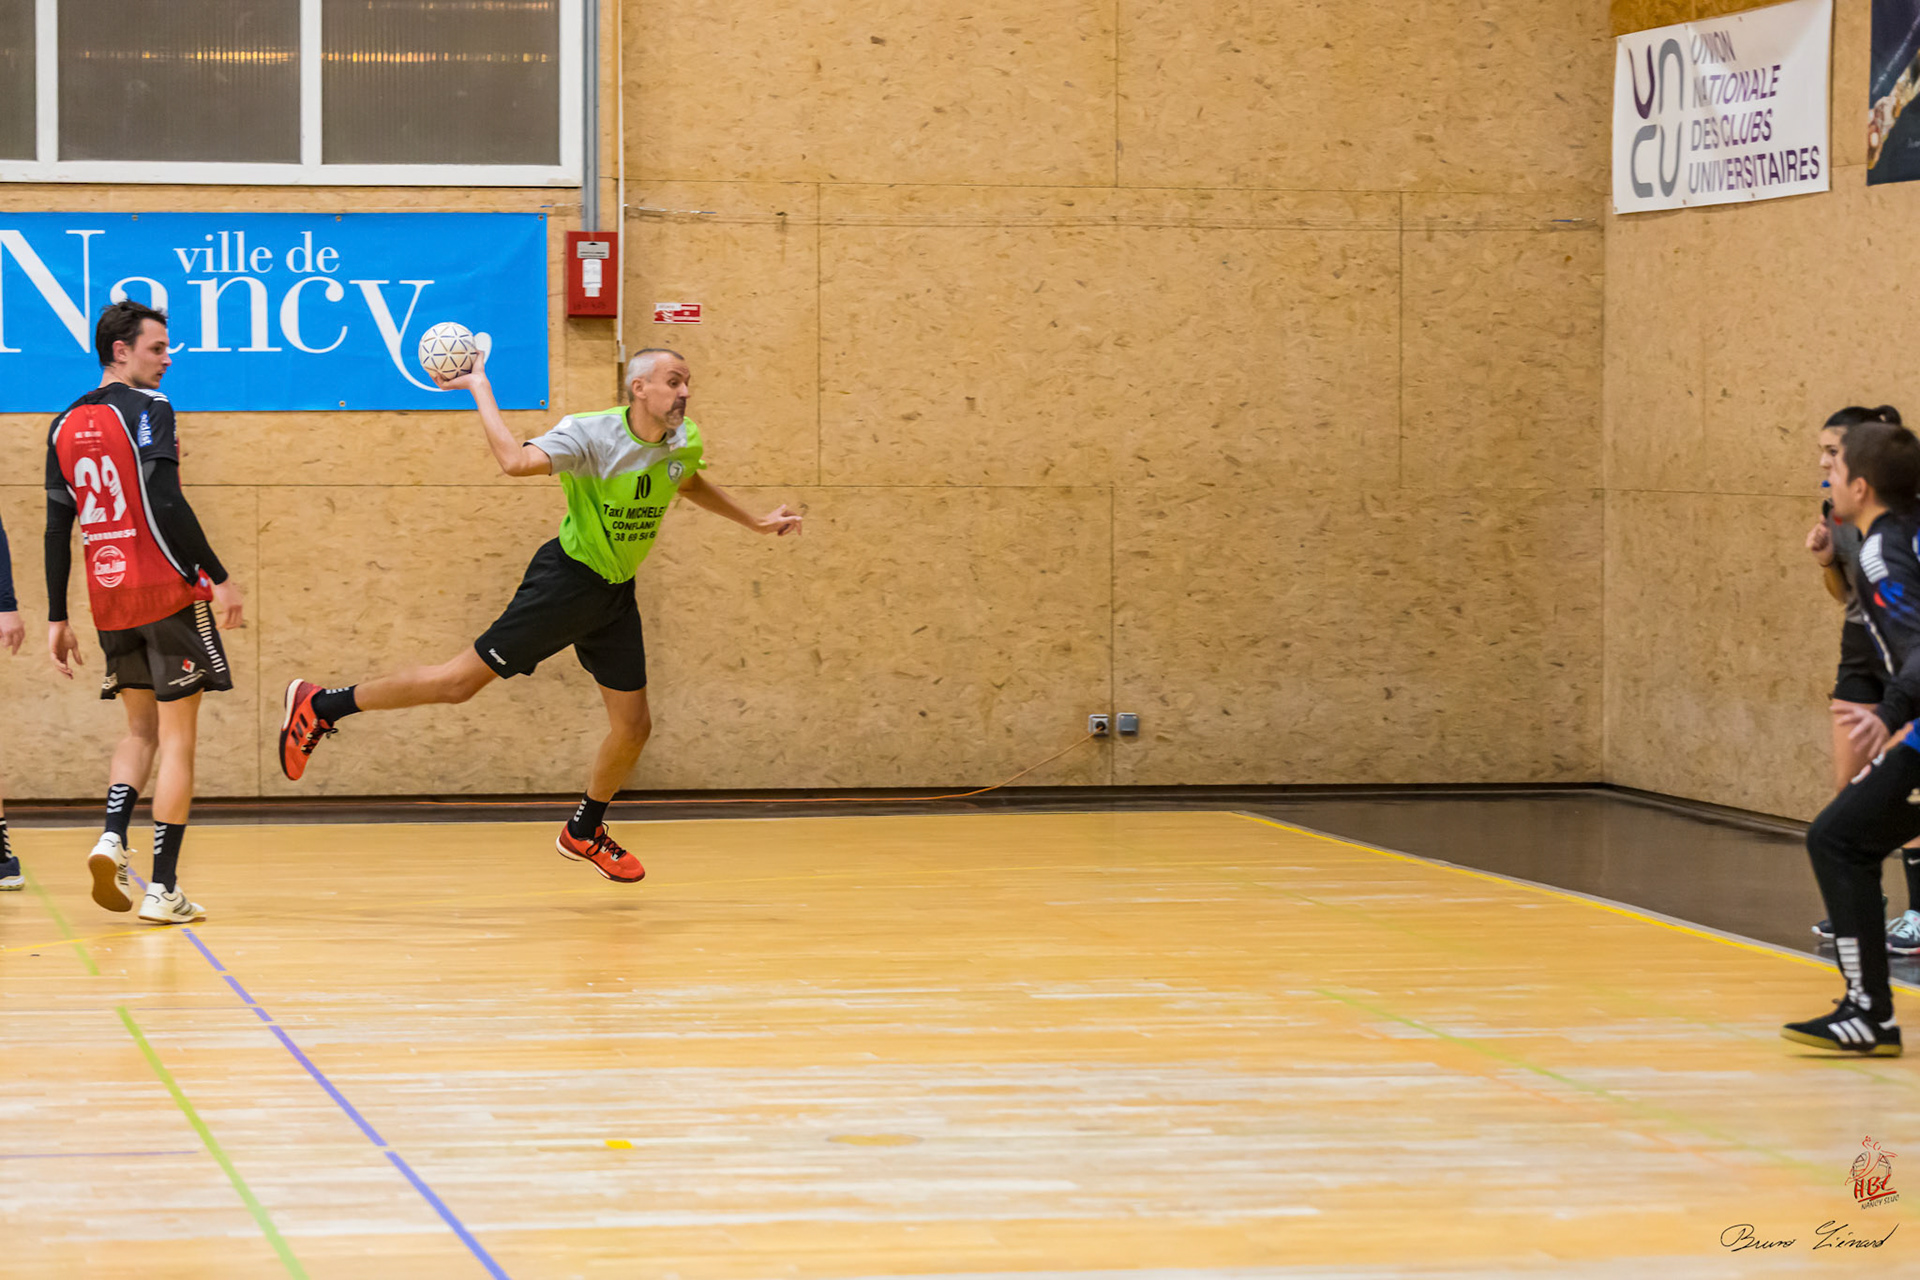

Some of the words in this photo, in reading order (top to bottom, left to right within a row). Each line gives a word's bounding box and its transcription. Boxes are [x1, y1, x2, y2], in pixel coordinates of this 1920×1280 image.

[1690, 30, 1737, 64] UNION
[1692, 64, 1781, 109] NATIONALE
[1691, 116, 1720, 152] DES
[1721, 108, 1774, 148] CLUBS
[1689, 145, 1821, 195] UNIVERSITAIRES
[173, 230, 275, 274] ville
[286, 230, 341, 274] de
[633, 473, 652, 500] 10
[603, 503, 625, 518] Taxi
[626, 506, 667, 519] MICHELE
